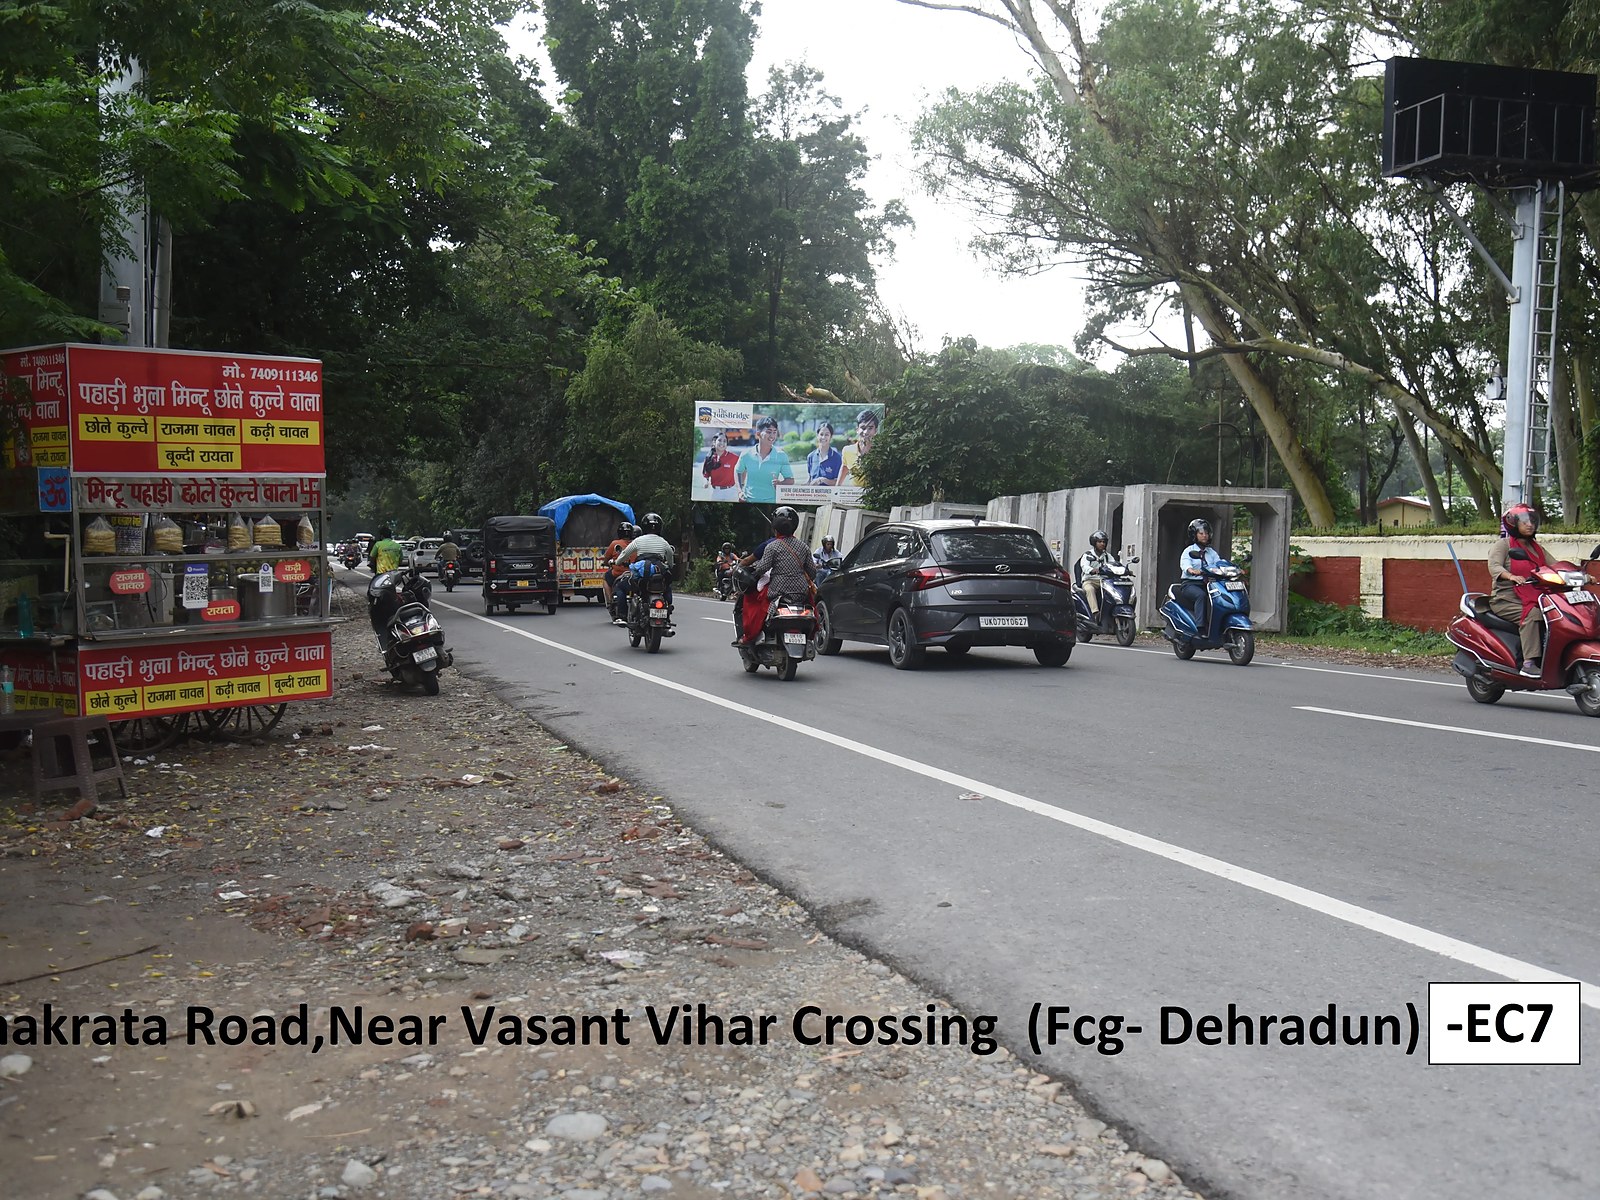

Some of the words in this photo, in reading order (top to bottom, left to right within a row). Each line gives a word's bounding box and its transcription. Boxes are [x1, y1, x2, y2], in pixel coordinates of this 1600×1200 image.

[222, 362, 245, 378] मो.
[250, 367, 318, 382] 7409111346
[36, 367, 65, 397] मिन्टू
[79, 378, 127, 411] पहाड़ी
[133, 385, 166, 414] भुला
[171, 381, 213, 416] मिन्टू
[213, 383, 244, 409] छोले
[249, 385, 284, 417] कुल्चे
[289, 392, 320, 411] वाला
[35, 400, 60, 419] वाला
[85, 417, 111, 433] छोले
[117, 418, 148, 439] कुल्चे
[161, 423, 199, 435] राजमा
[203, 424, 236, 436] चावल
[250, 423, 275, 441] कढ़ी
[279, 427, 309, 438] चावल
[165, 447, 195, 466] बून्दी
[199, 451, 234, 462] रायता
[84, 477, 128, 508] मिन्टू
[127, 478, 174, 507] पहाड़ी
[219, 478, 260, 508] कुल्चे
[262, 484, 298, 502] वाला
[116, 573, 145, 582] राजमा
[117, 582, 145, 590] चावल
[282, 573, 305, 581] चावल
[207, 606, 235, 616] रायता
[984, 618, 1027, 626] UK07DY0627
[85, 656, 133, 684] पहाड़ी
[139, 658, 172, 682] भुला
[178, 651, 218, 676] मिन्टू
[220, 646, 249, 668] छोले
[254, 642, 290, 671] कुल्चे
[294, 645, 325, 661] वाला
[215, 681, 234, 698] कढ़ी
[237, 682, 261, 693] चावल
[274, 675, 294, 694] बून्दी
[297, 675, 321, 688] रायता
[90, 692, 110, 708] छोले
[114, 690, 137, 710] कुल्चे
[147, 689, 176, 703] राजमा
[179, 687, 205, 700] चावल
